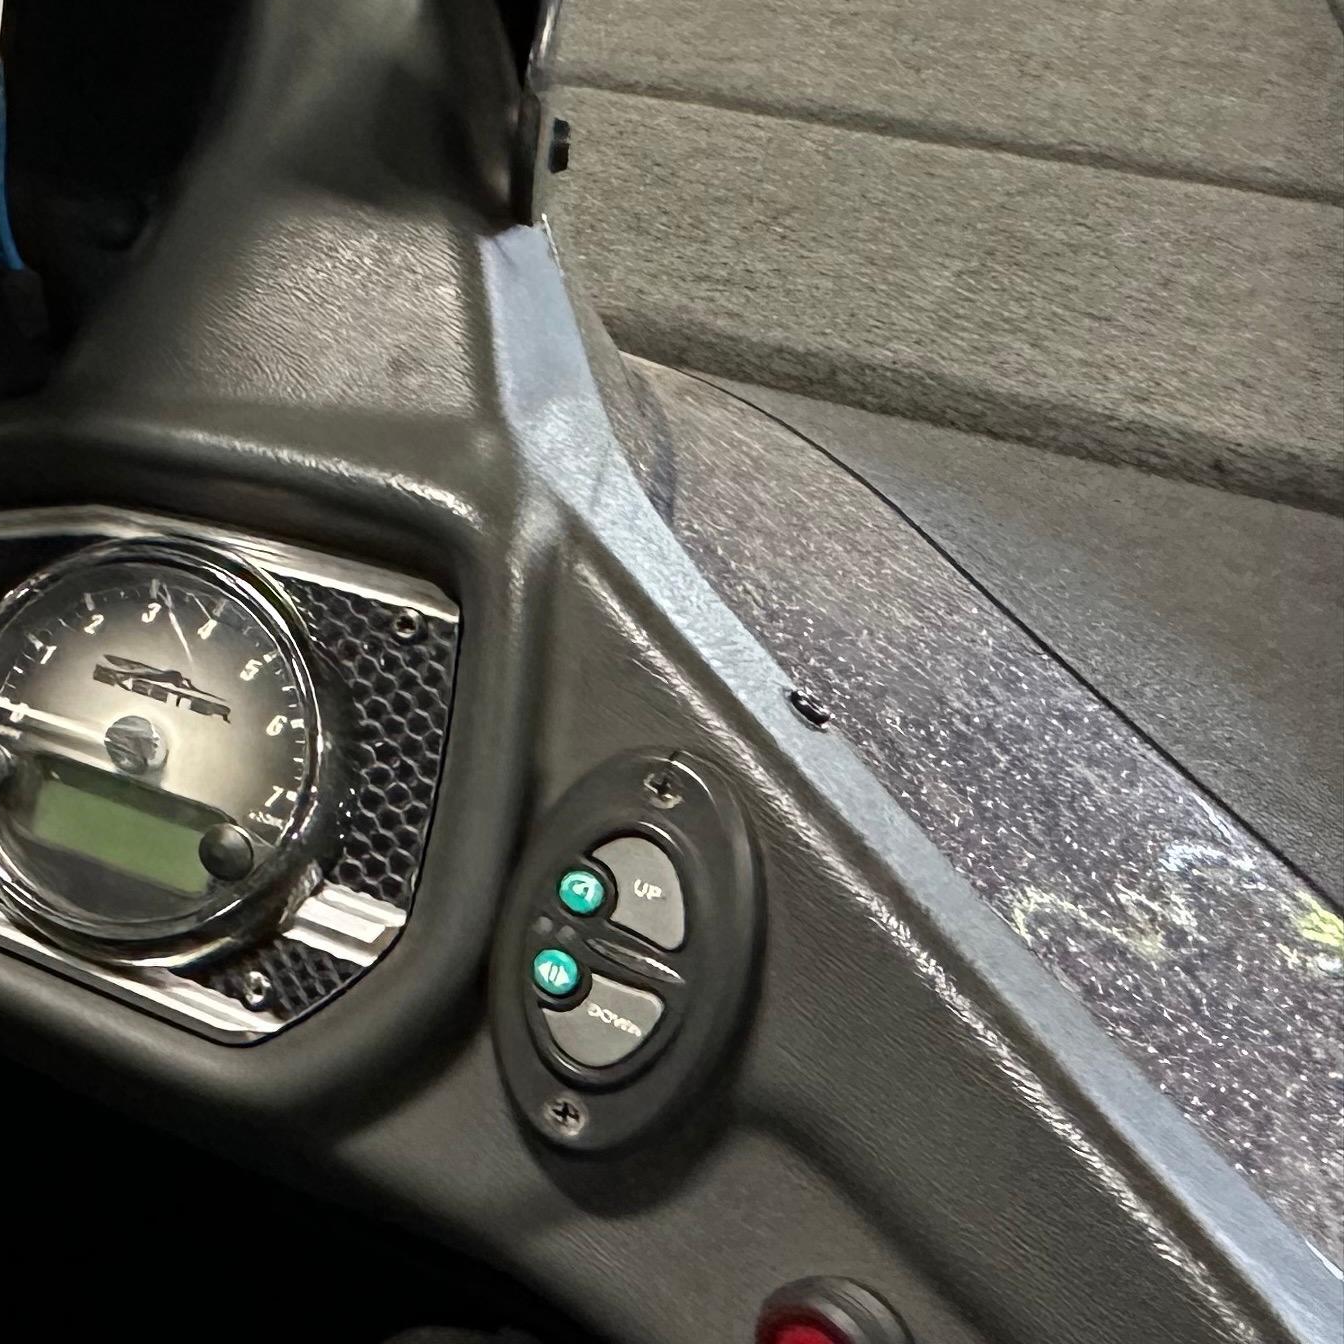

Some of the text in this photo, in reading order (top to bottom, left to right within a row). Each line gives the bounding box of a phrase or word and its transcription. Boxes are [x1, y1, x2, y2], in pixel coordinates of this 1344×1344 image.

[83, 613, 105, 635] 2
[140, 602, 162, 624] 3
[239, 657, 264, 682] 5
[265, 714, 288, 737] 6
[263, 785, 285, 808] 7
[633, 878, 664, 901] UP
